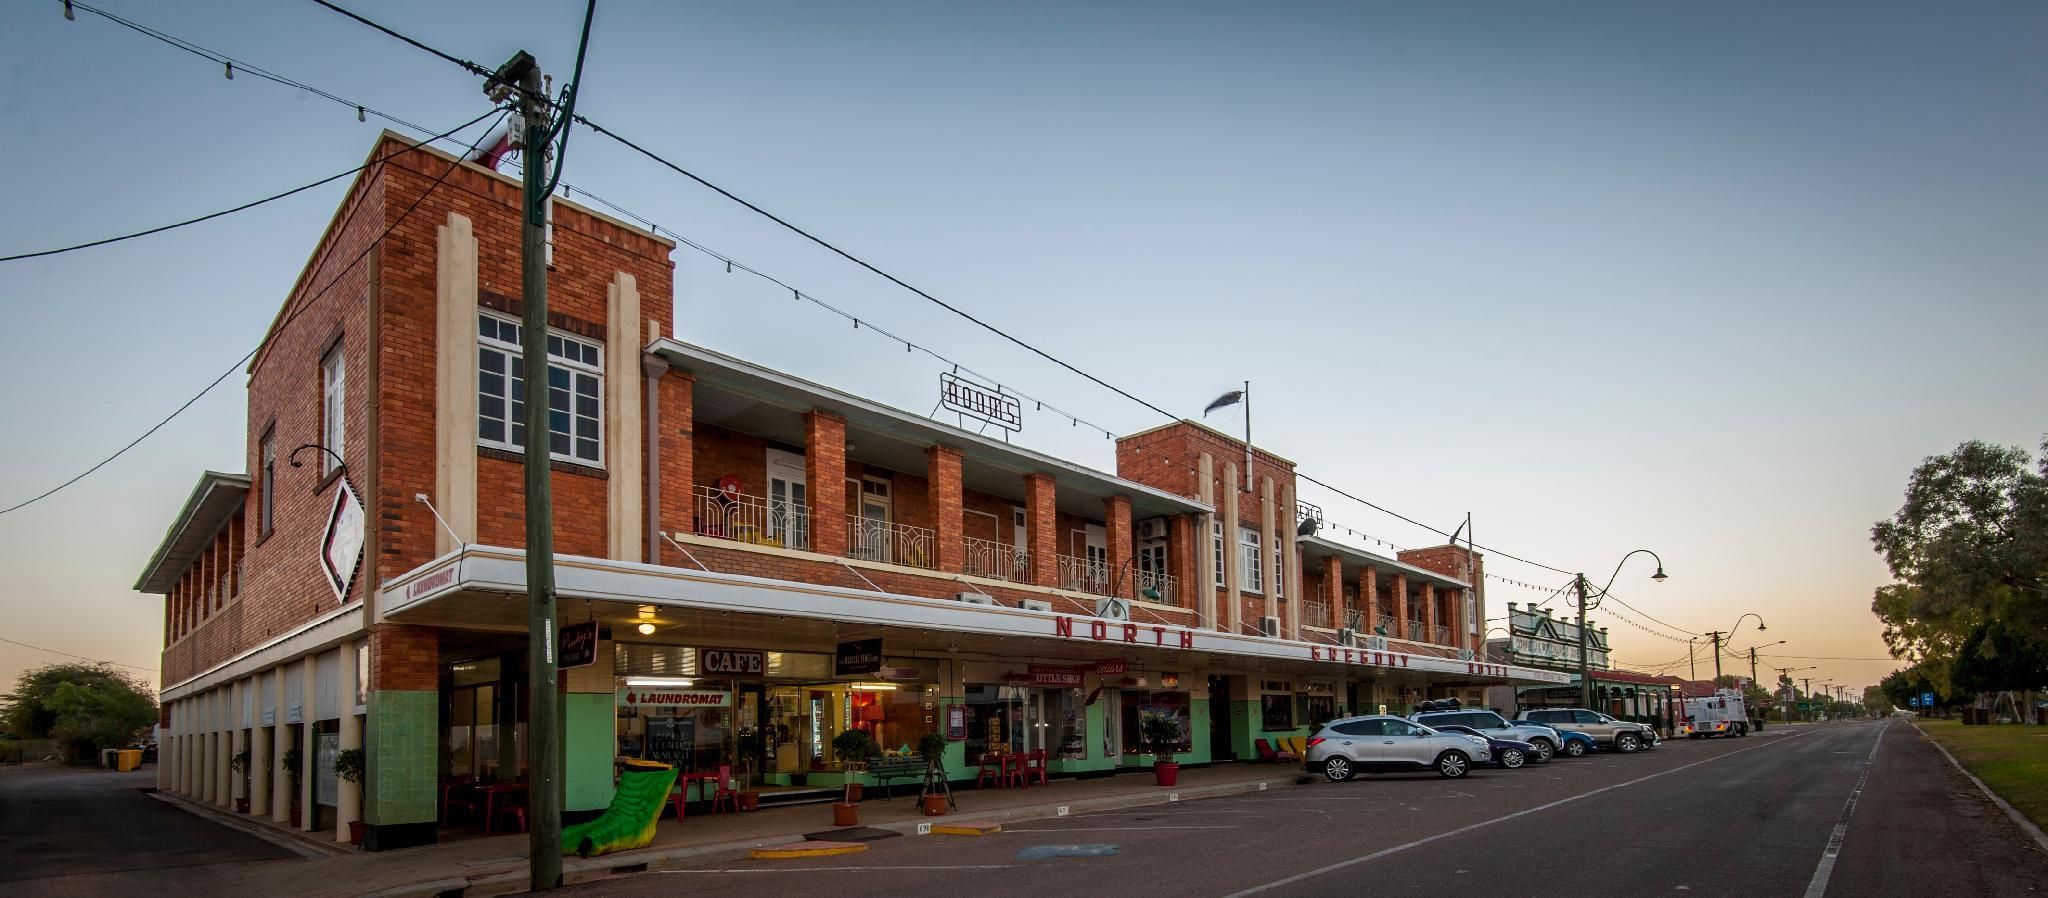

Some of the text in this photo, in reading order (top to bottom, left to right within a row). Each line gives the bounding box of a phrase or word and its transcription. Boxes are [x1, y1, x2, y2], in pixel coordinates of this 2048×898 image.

[948, 381, 1015, 424] ROOMS
[413, 567, 454, 597] LAUNDROMAT
[1056, 615, 1507, 676] NORTH GREGORY HOTEL
[704, 651, 762, 673] CAFE
[1096, 663, 1124, 674] cellars
[1062, 674, 1081, 684] SHOP
[640, 693, 724, 705] LAUNDROMAT
